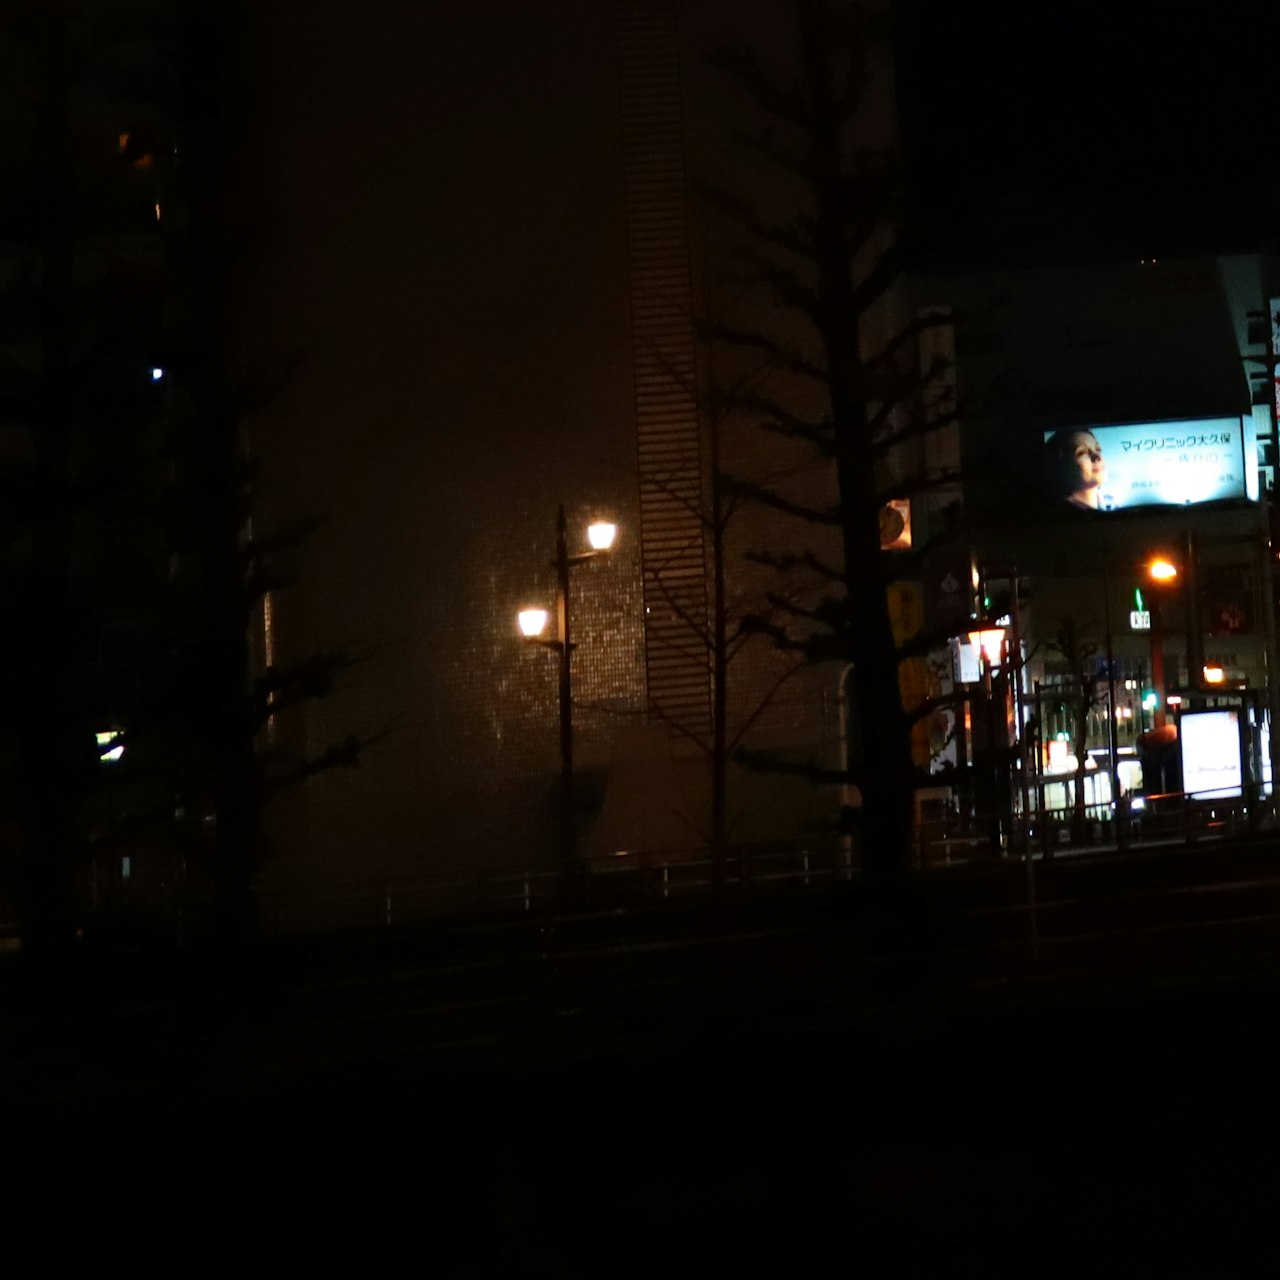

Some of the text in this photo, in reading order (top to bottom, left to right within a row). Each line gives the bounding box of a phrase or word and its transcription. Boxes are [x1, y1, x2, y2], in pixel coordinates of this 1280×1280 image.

[1121, 432, 1232, 453] マイクリニック大久保
